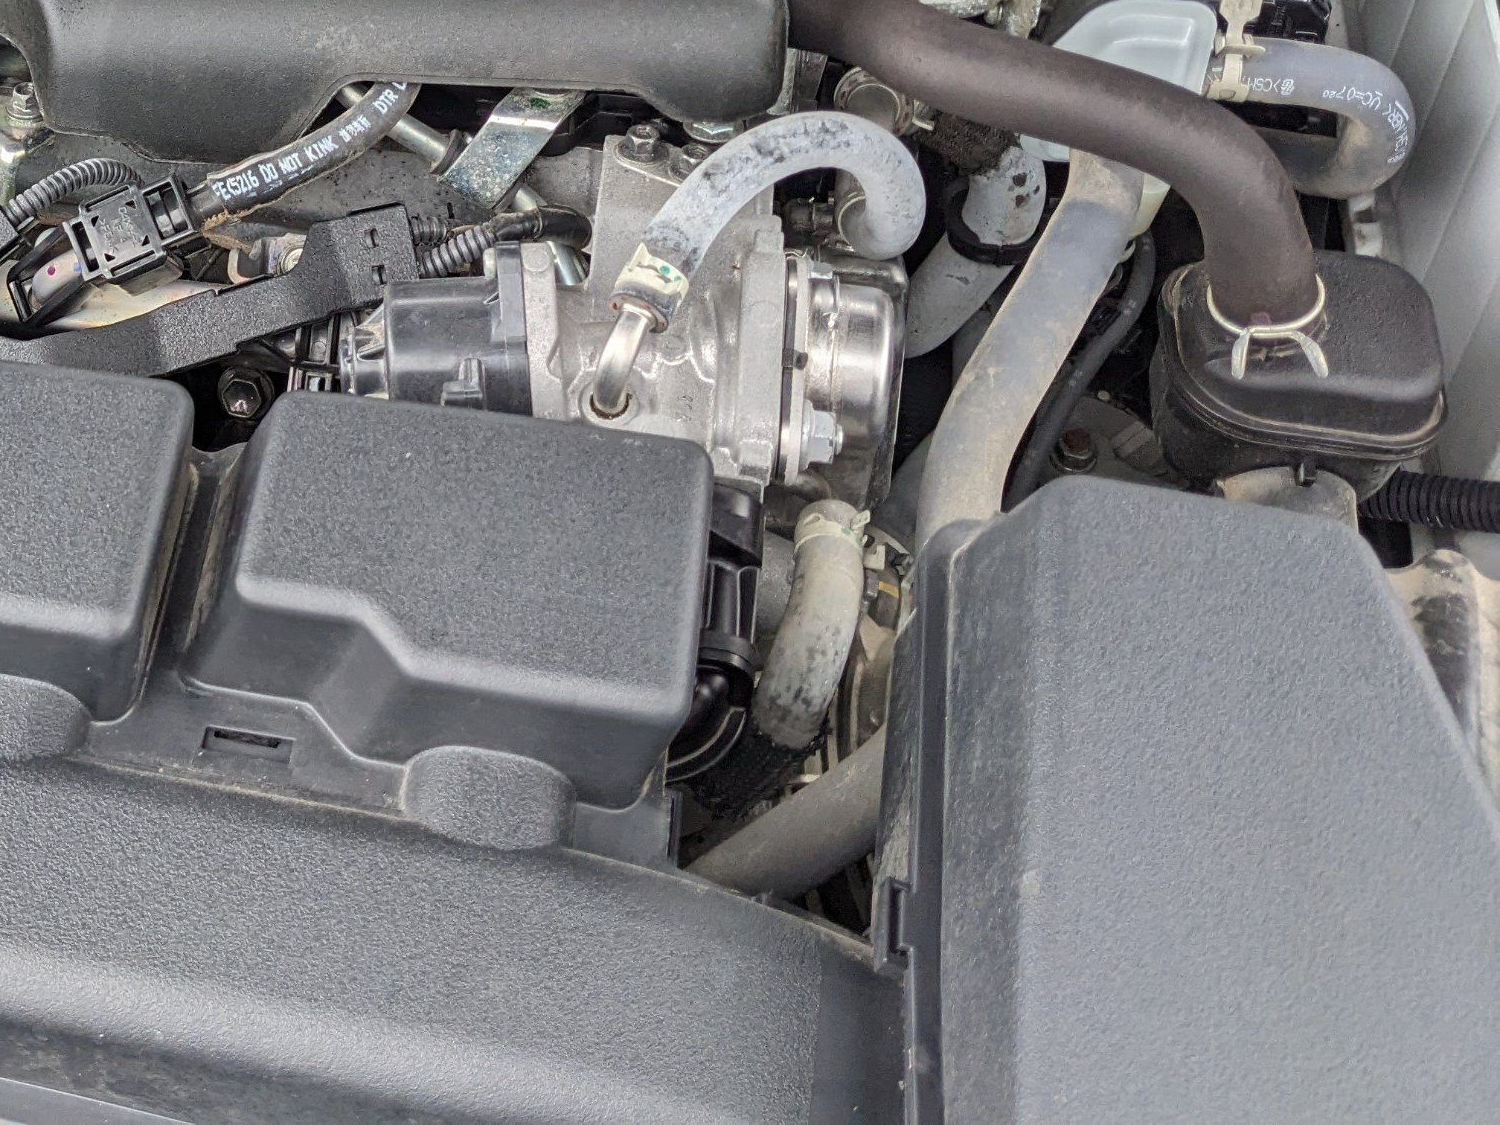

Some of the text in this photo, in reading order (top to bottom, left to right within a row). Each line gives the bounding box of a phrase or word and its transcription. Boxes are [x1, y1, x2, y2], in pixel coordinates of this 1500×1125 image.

[258, 163, 279, 183] DO
[278, 151, 303, 174] NOT
[304, 136, 339, 163] KINK
[372, 88, 399, 115] DTR
